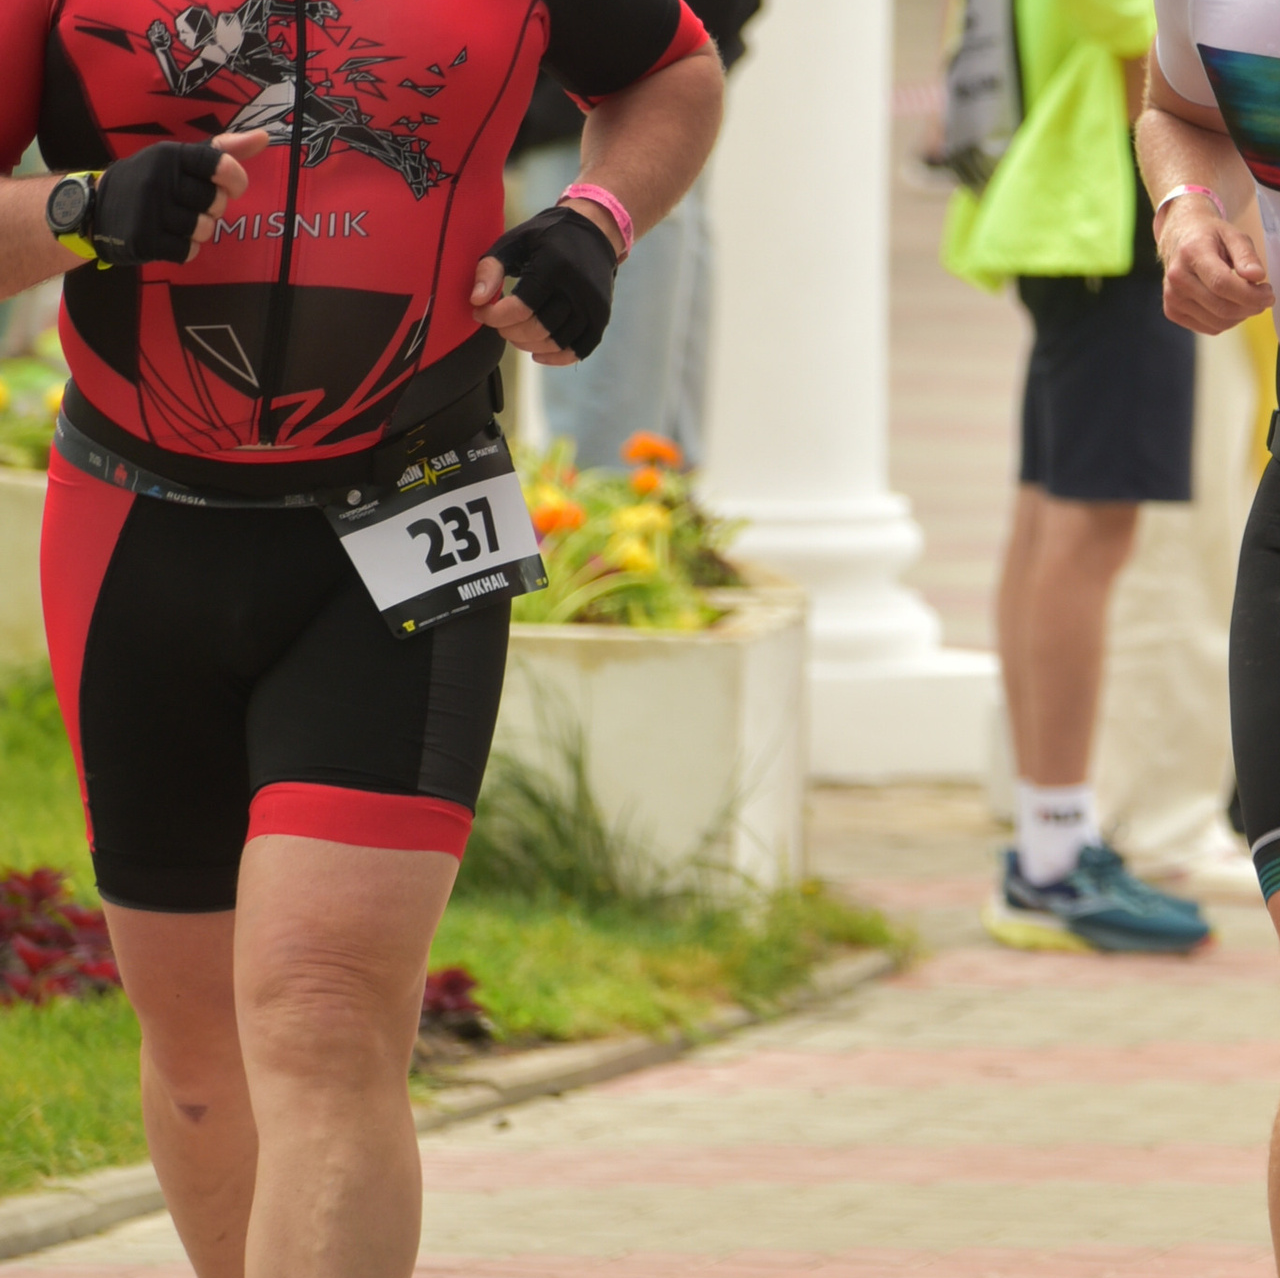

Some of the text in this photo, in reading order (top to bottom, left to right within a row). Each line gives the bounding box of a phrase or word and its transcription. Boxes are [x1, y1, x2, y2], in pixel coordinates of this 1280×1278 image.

[212, 210, 370, 245] MISNIK
[430, 449, 460, 471] STAR
[166, 490, 208, 506] RUSSIA
[405, 496, 500, 575] 237
[457, 571, 510, 602] MIKHAIL
